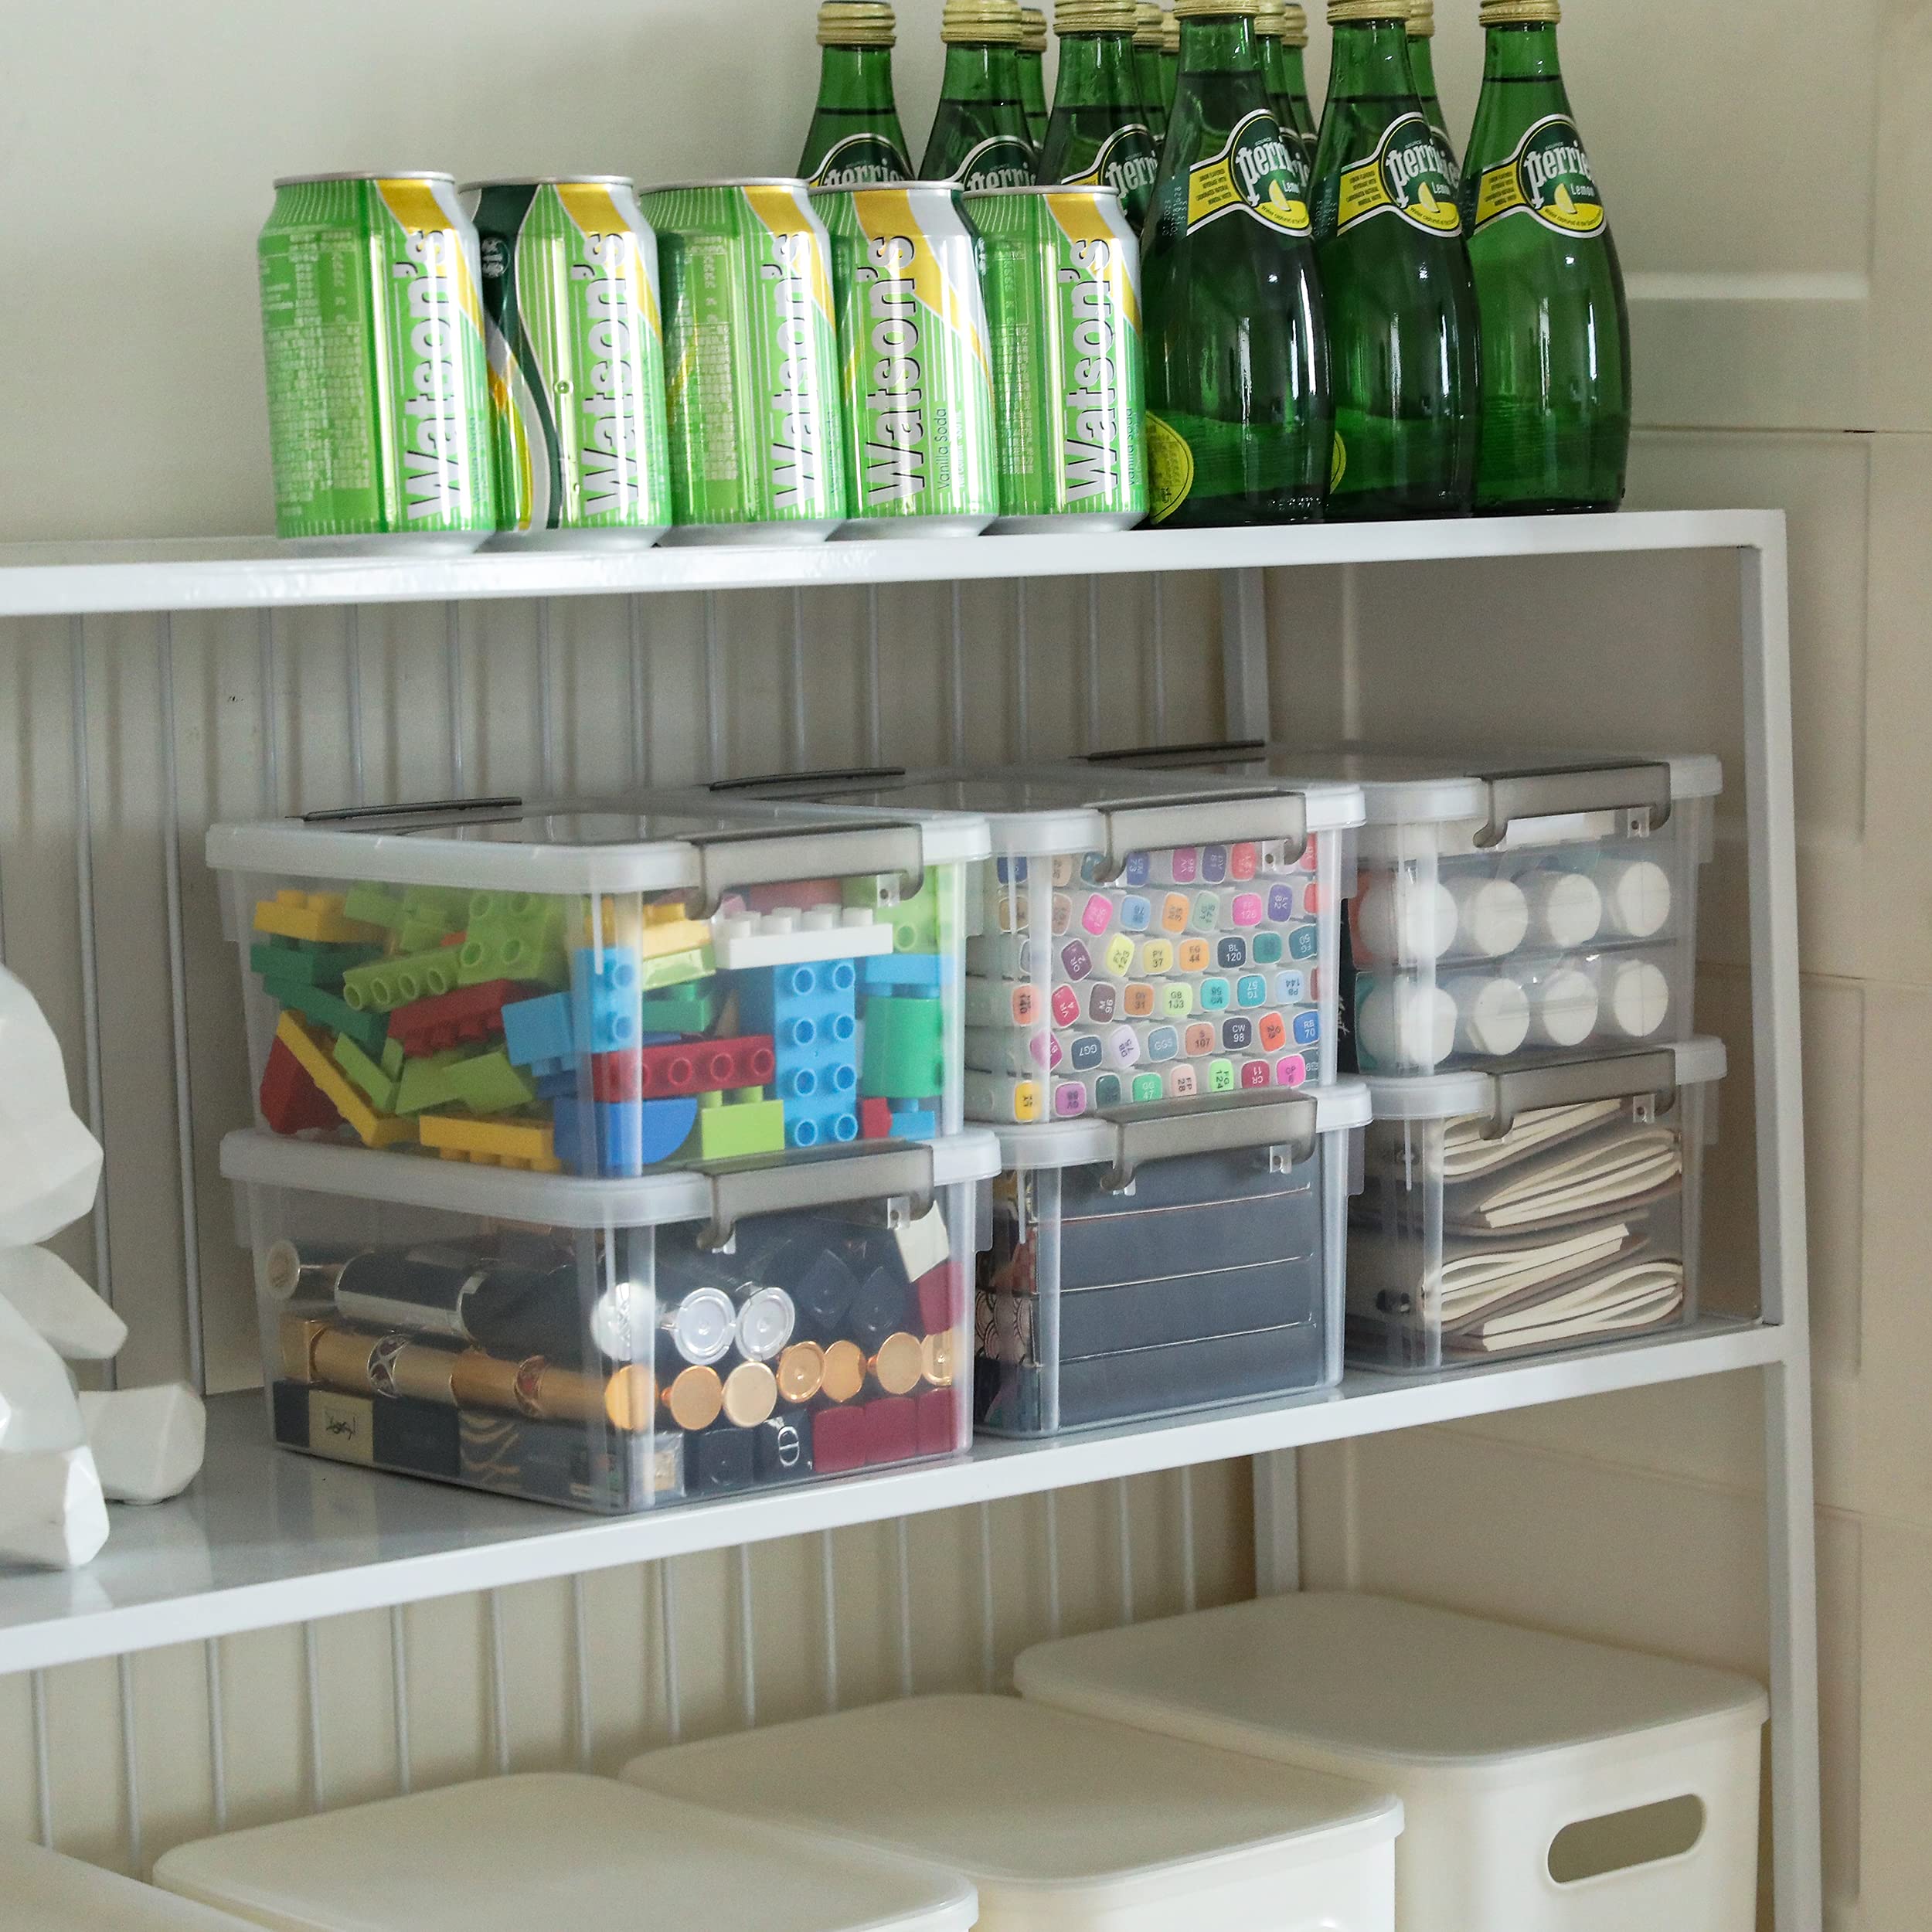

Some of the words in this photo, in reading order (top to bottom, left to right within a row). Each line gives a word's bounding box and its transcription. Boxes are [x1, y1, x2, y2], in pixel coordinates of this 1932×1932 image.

[393, 230, 461, 520] Watson's
[571, 233, 639, 515] Watson's
[760, 233, 820, 509] Watson's
[856, 236, 926, 506] Watson's
[1059, 239, 1118, 503] Watson's
[936, 407, 947, 443] Soda
[937, 445, 951, 490] Vanilla
[1226, 952, 1242, 961] 120
[1228, 944, 1239, 952] BL
[1104, 999, 1114, 1013] 96
[1079, 1044, 1097, 1056] GG7
[1233, 1032, 1245, 1043] 98
